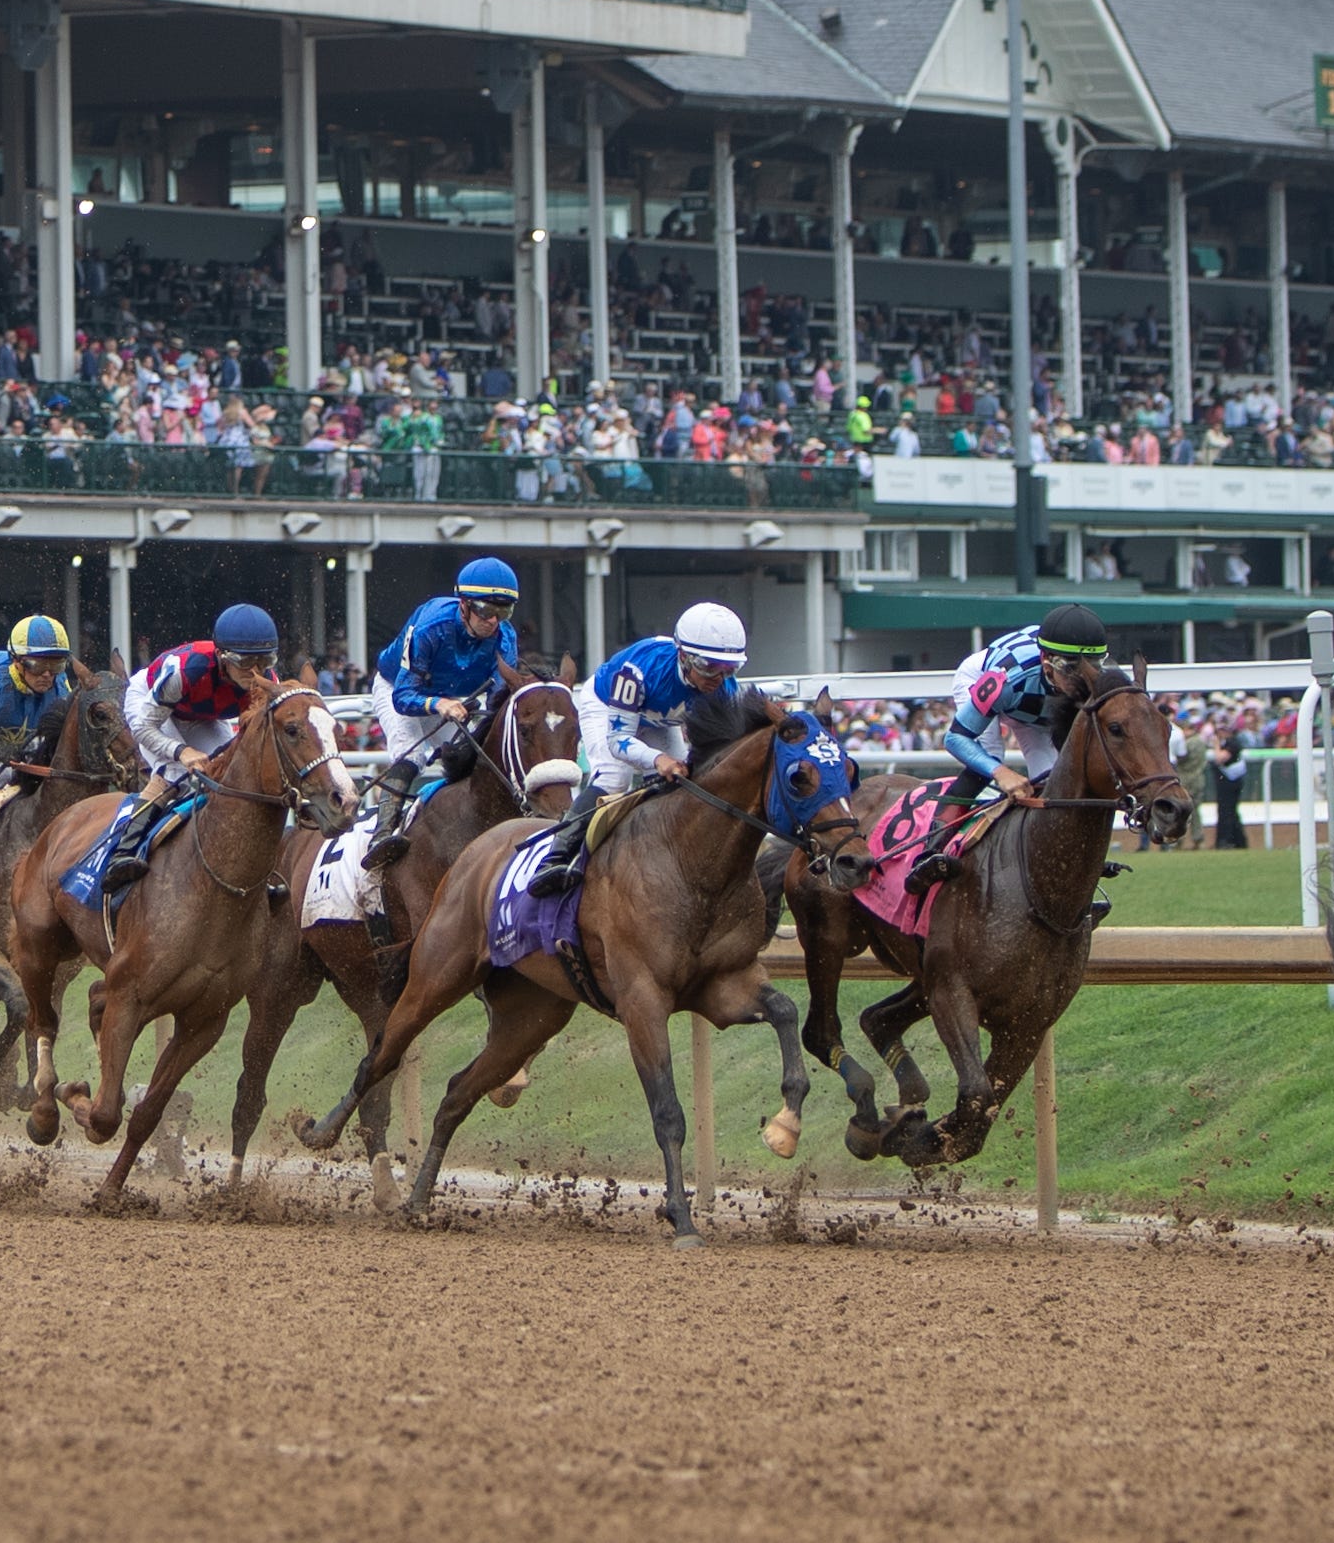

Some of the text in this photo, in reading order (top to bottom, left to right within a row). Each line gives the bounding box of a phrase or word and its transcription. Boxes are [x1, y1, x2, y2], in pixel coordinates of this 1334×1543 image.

[613, 674, 637, 706] 10
[976, 677, 998, 703] 8
[818, 743, 835, 760] S
[882, 782, 942, 851] 8
[499, 828, 555, 900] 10
